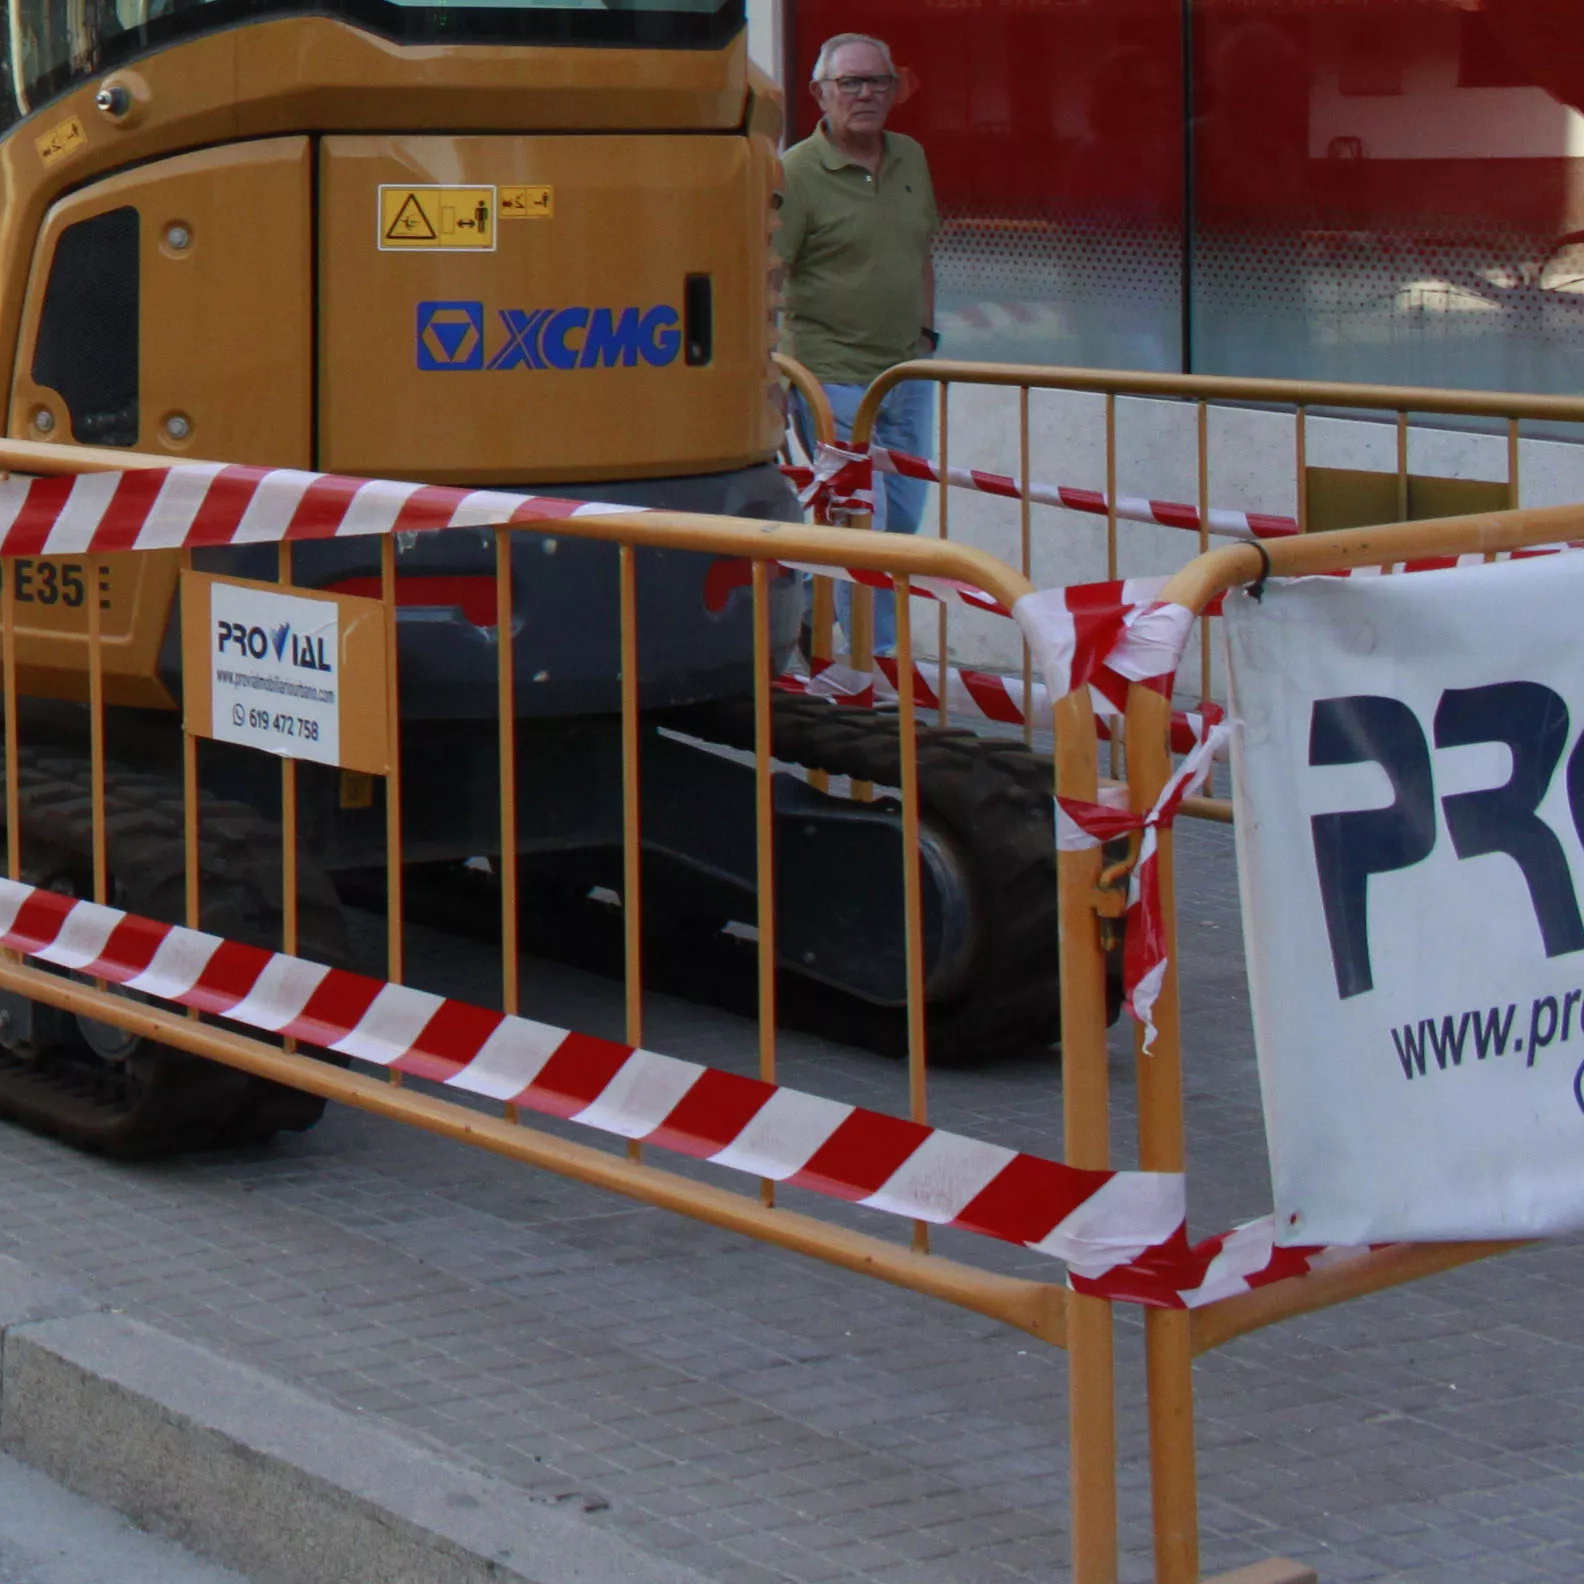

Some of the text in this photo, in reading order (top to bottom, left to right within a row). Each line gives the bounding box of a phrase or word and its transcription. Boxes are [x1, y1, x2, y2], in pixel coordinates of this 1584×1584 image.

[486, 305, 682, 371] XCMG
[217, 620, 332, 672] PROVIAL
[249, 707, 320, 742] 619 472 758
